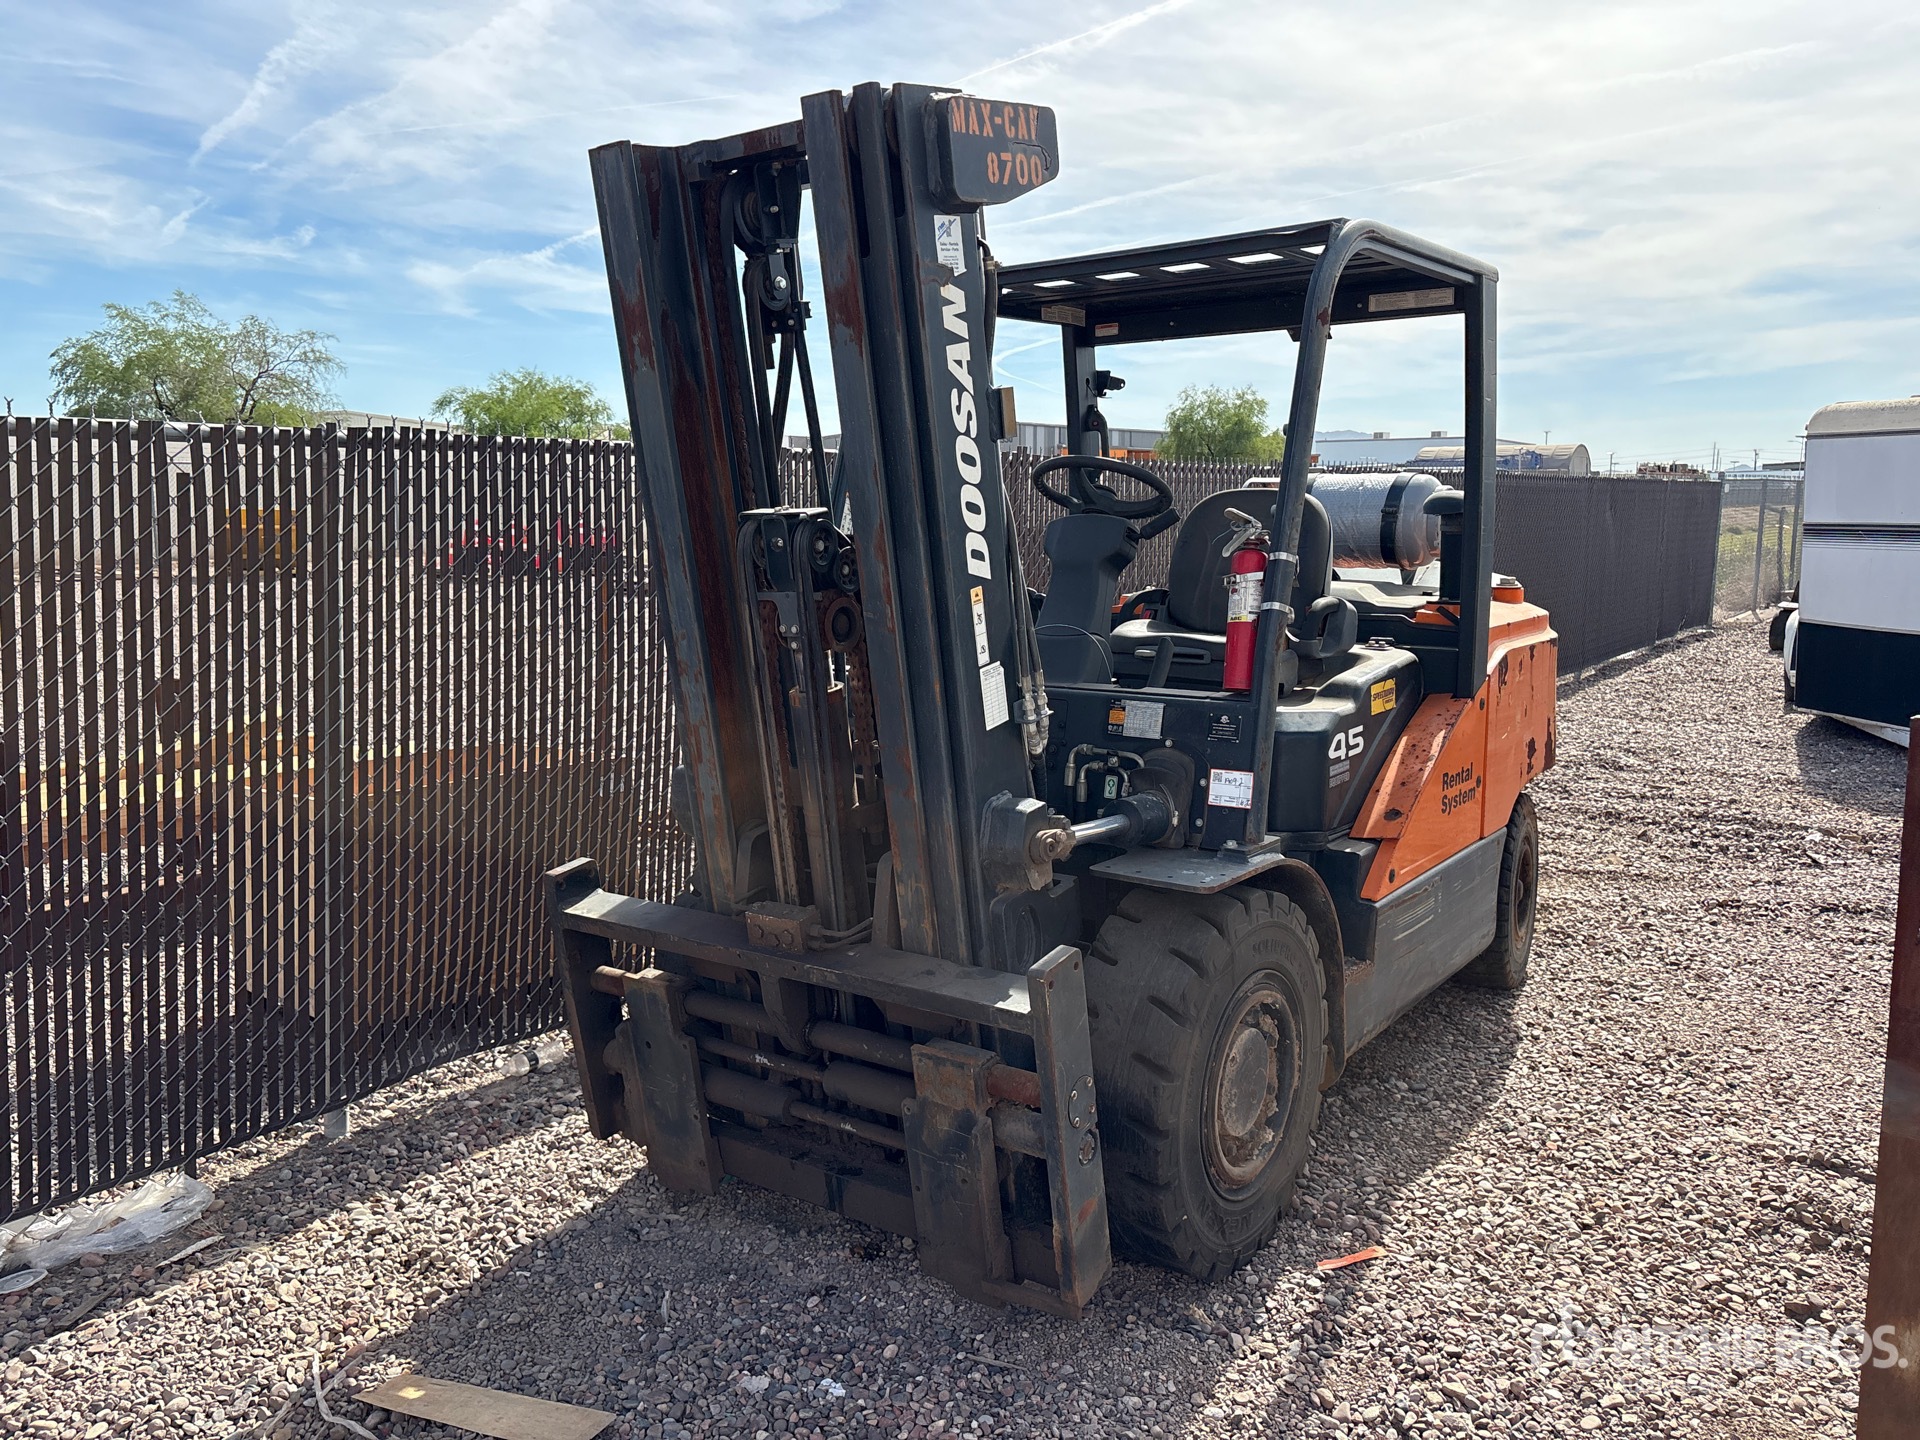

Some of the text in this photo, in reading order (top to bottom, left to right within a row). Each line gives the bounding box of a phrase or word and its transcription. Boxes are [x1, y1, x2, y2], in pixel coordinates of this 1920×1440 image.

[986, 152, 1043, 186] 8700
[941, 282, 992, 580] DOOSAN
[1328, 725, 1364, 760] 45
[1442, 762, 1473, 792] Rental
[1441, 786, 1476, 816] System
